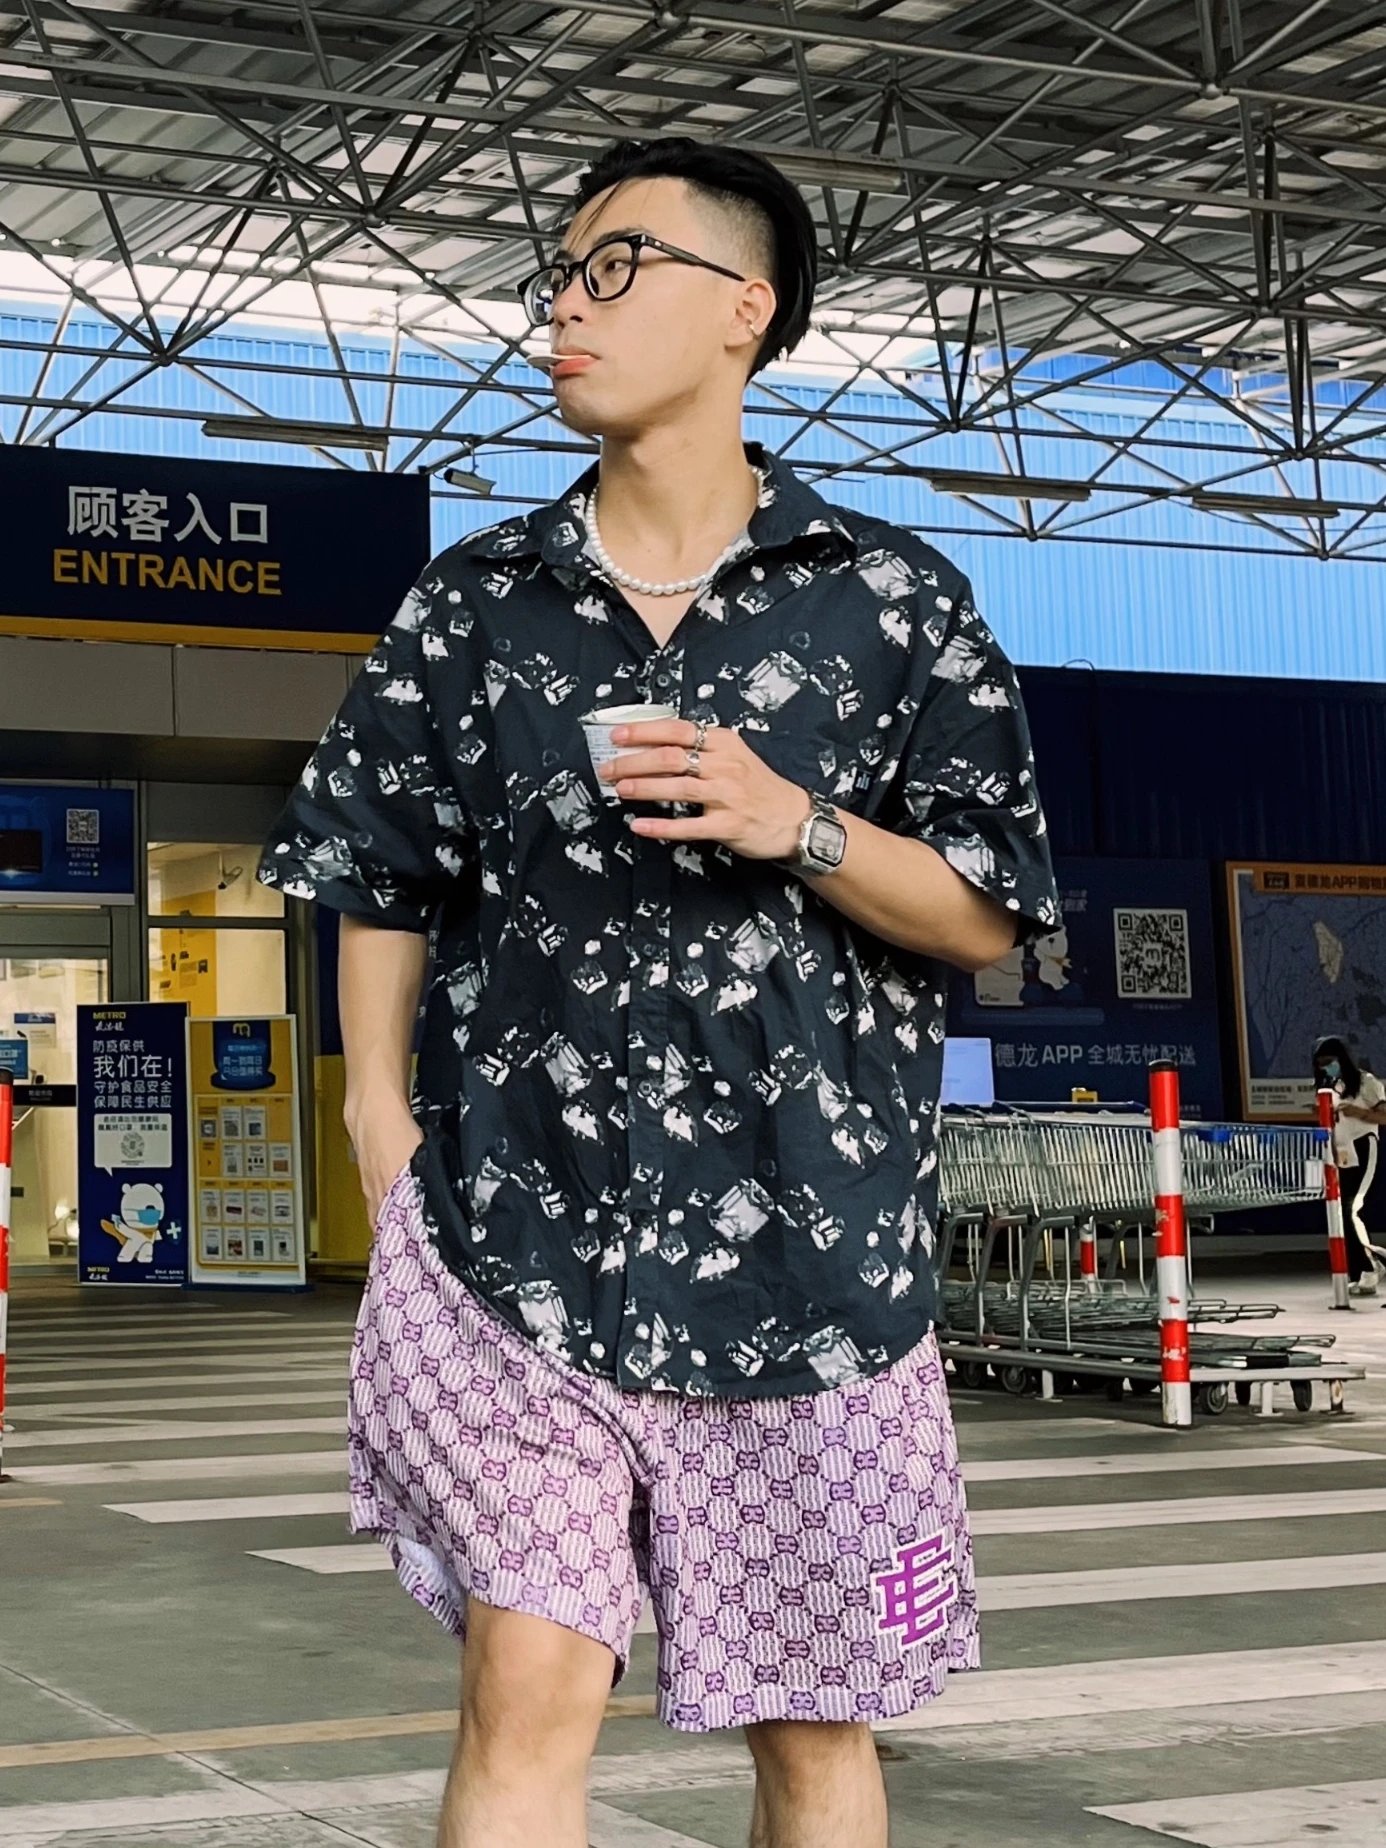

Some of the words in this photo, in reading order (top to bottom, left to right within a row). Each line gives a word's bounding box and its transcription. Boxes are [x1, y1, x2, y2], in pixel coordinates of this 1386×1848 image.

[67, 485, 269, 544] 顾客入口
[53, 549, 282, 595] ENTRANCE
[93, 1012, 126, 1020] METRO
[93, 1040, 145, 1053] 防疫保供
[1042, 1045, 1083, 1064] APP
[94, 1080, 173, 1094] 守护食品安全
[94, 1095, 172, 1109] 保障民生供应
